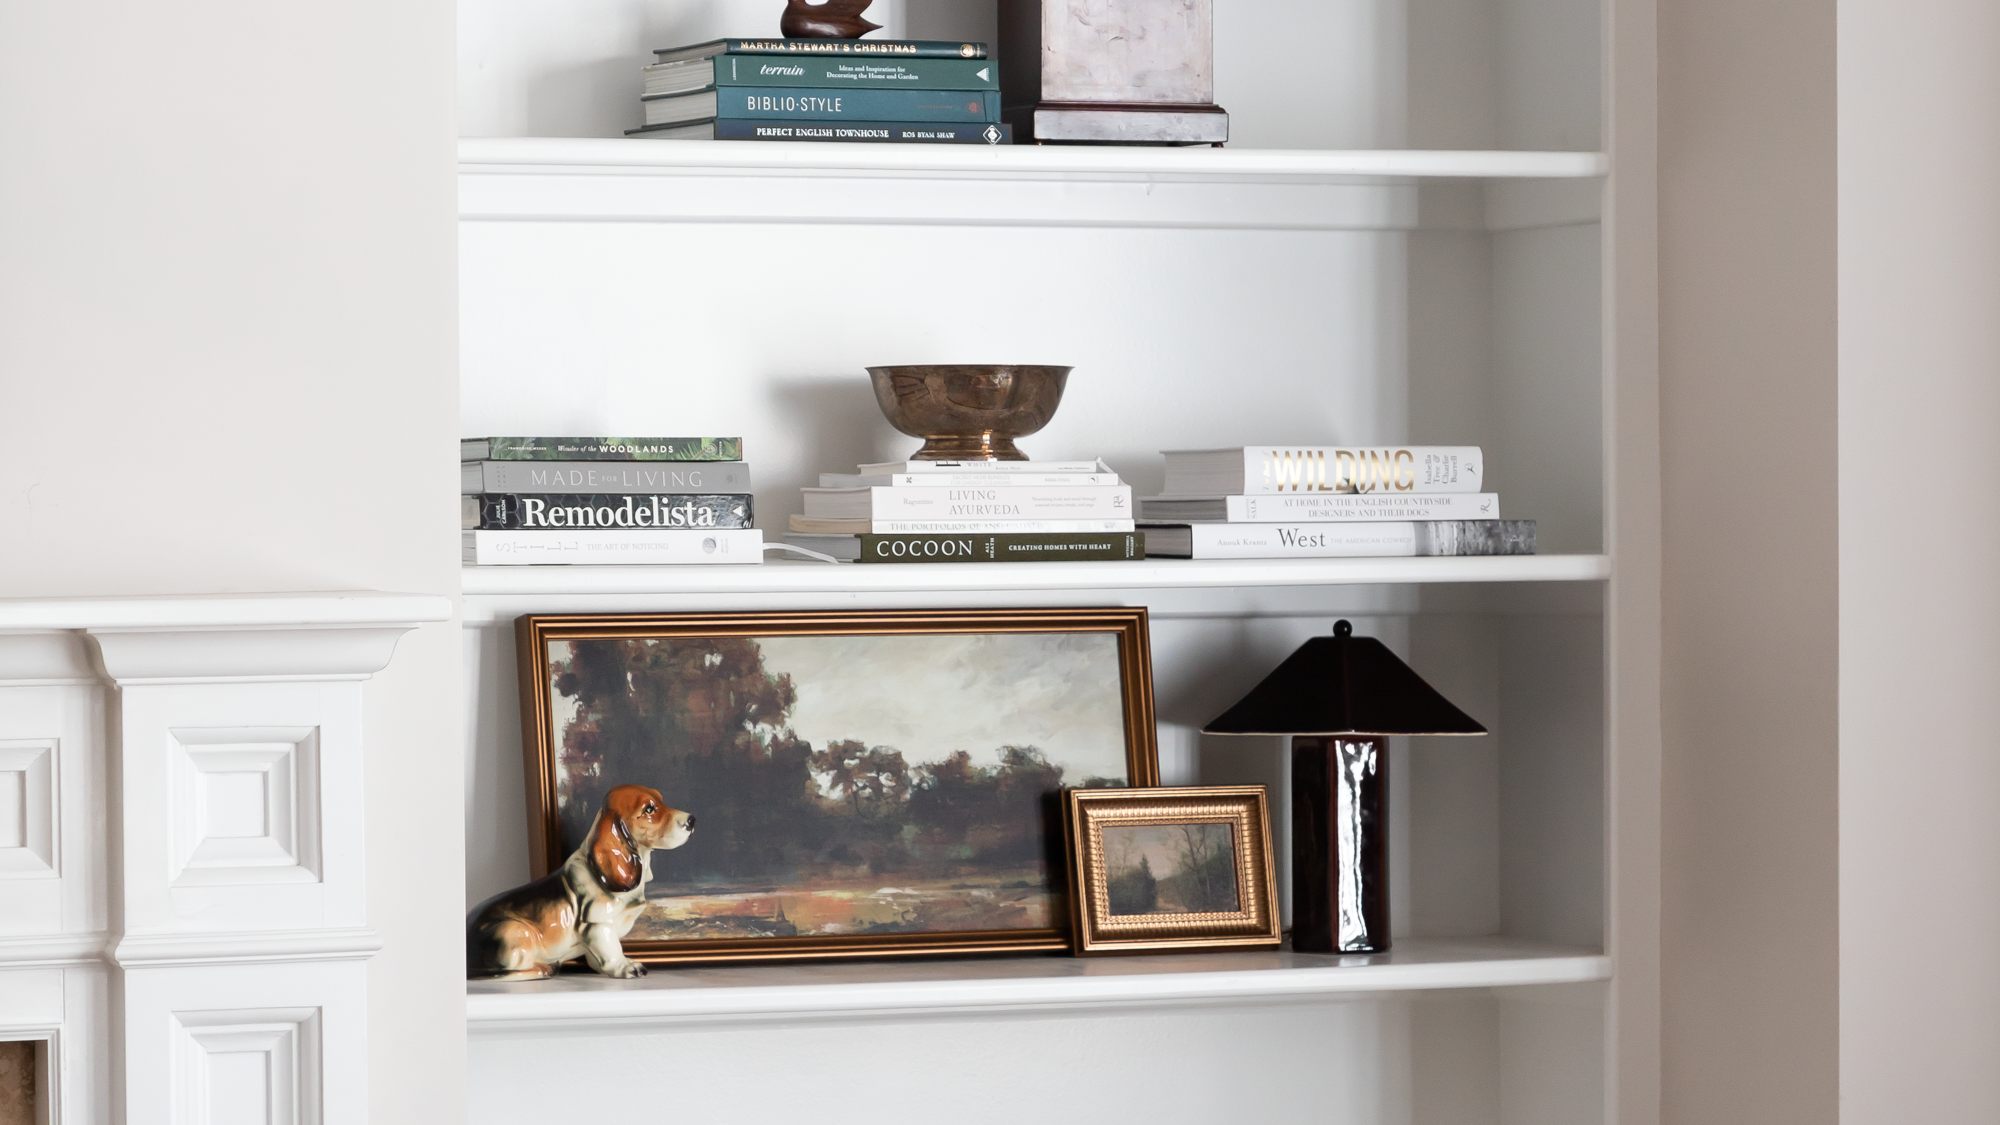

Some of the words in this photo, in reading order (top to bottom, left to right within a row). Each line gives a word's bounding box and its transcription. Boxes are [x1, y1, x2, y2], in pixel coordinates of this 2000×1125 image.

[740, 41, 786, 50] MARTHA
[789, 42, 850, 52] STEWART'S
[853, 43, 917, 53] CHRISTMAS
[760, 64, 806, 76] terrain
[756, 128, 793, 136] PERFECT
[795, 129, 833, 137] ENGLISH
[835, 129, 890, 138] TOWNHOUSE
[580, 445, 587, 454] of
[598, 445, 674, 454] WOODLANDS
[1272, 450, 1415, 492] WILDING
[1424, 454, 1432, 485] Isabella
[1433, 466, 1441, 484] Tree
[1442, 454, 1450, 485] Charlie
[1450, 455, 1458, 483] Burrell
[531, 469, 598, 486] MADE
[622, 470, 702, 487] LIVING
[949, 490, 996, 500] LIVING
[903, 498, 934, 506] Ragozzino
[1284, 499, 1295, 507] AT
[1355, 498, 1393, 506] ENGLISH
[1394, 498, 1454, 506] COUNTRYSIDE
[521, 496, 716, 527] Remodelista
[949, 505, 1020, 515] AYURVEDA
[1308, 509, 1356, 518] DESIGNERS
[1358, 509, 1377, 517] AND
[1378, 509, 1405, 517] THEIR
[1406, 509, 1430, 517] DOGS
[1276, 528, 1327, 548] West
[586, 543, 602, 551] THE
[603, 543, 619, 551] ART
[620, 543, 630, 551] OF
[632, 543, 669, 551] NOTICING
[876, 540, 973, 557] COCOON
